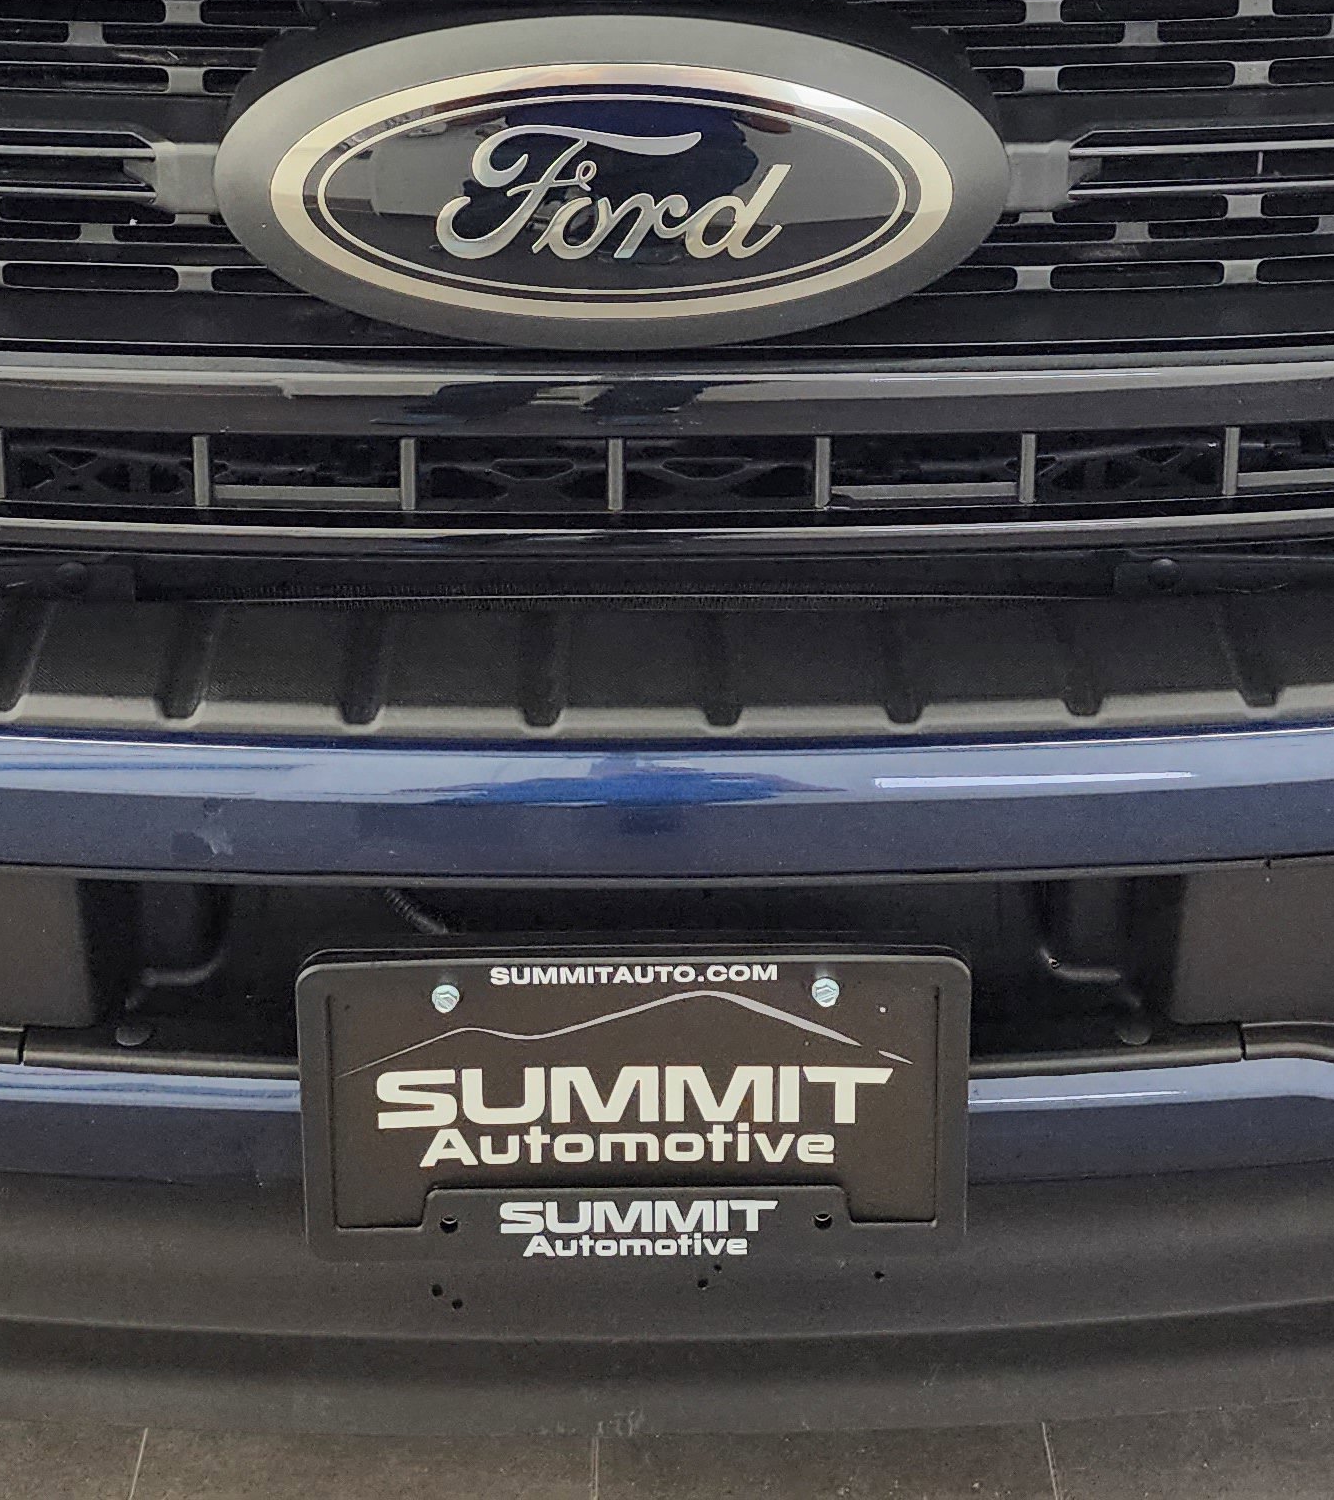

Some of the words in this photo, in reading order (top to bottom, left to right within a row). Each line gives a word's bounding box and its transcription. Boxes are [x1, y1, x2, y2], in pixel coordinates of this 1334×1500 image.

[436, 123, 792, 261] Ford
[490, 963, 779, 986] SUMMITAUTO.COM
[375, 1064, 895, 1130] SUMMIT
[419, 1122, 836, 1168] Automotive
[499, 1199, 780, 1234] SUMMIT
[522, 1233, 749, 1258] Automotive
